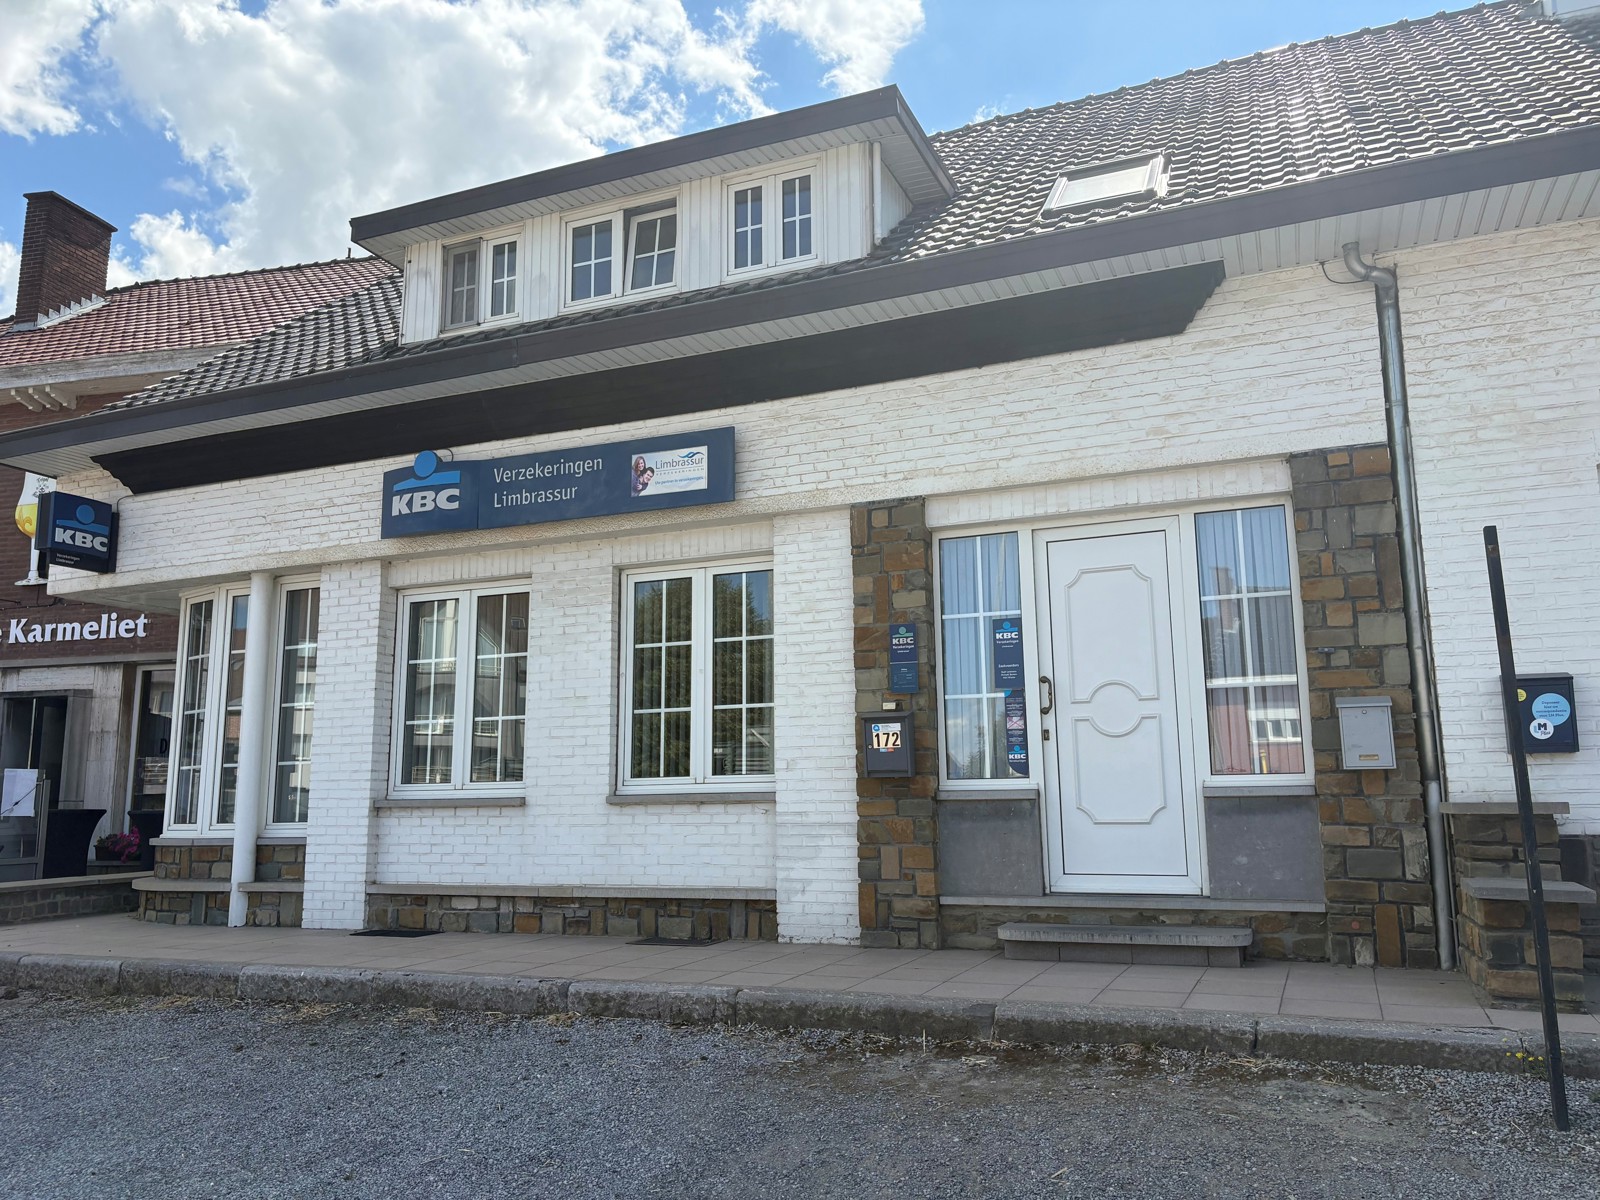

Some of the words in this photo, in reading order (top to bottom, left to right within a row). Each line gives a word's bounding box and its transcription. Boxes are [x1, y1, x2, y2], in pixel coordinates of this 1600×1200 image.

[494, 458, 603, 483] Verzekeringen
[655, 457, 705, 470] Limbrassur
[391, 488, 460, 517] KBC
[494, 486, 578, 508] Limbrassur
[54, 527, 109, 552] KBC
[8, 612, 148, 644] Karmeliet
[995, 632, 1019, 640] KBC
[892, 637, 914, 645] KBC
[875, 732, 900, 748] 172
